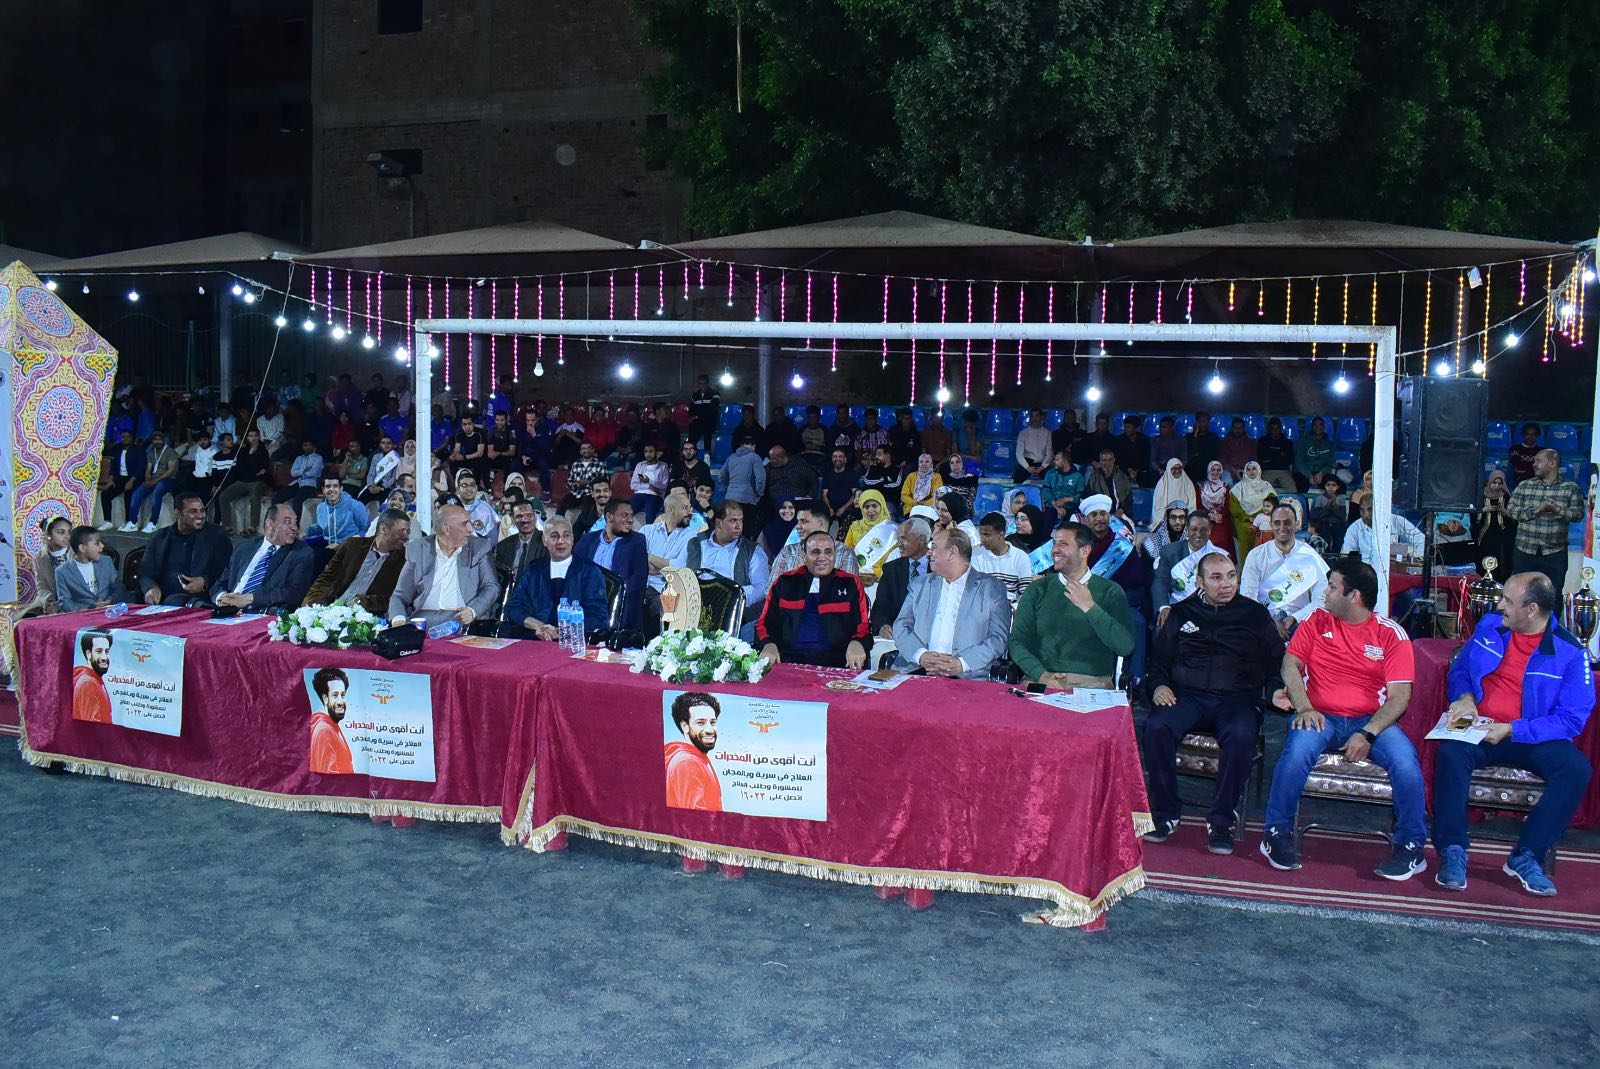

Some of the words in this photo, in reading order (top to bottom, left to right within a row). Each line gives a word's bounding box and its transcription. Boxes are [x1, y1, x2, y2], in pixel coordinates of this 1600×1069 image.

[715, 751, 752, 763] المخدرات
[753, 755, 769, 765] من
[770, 753, 796, 766] أقوى
[797, 754, 816, 767] أنت
[755, 771, 776, 780] سرية
